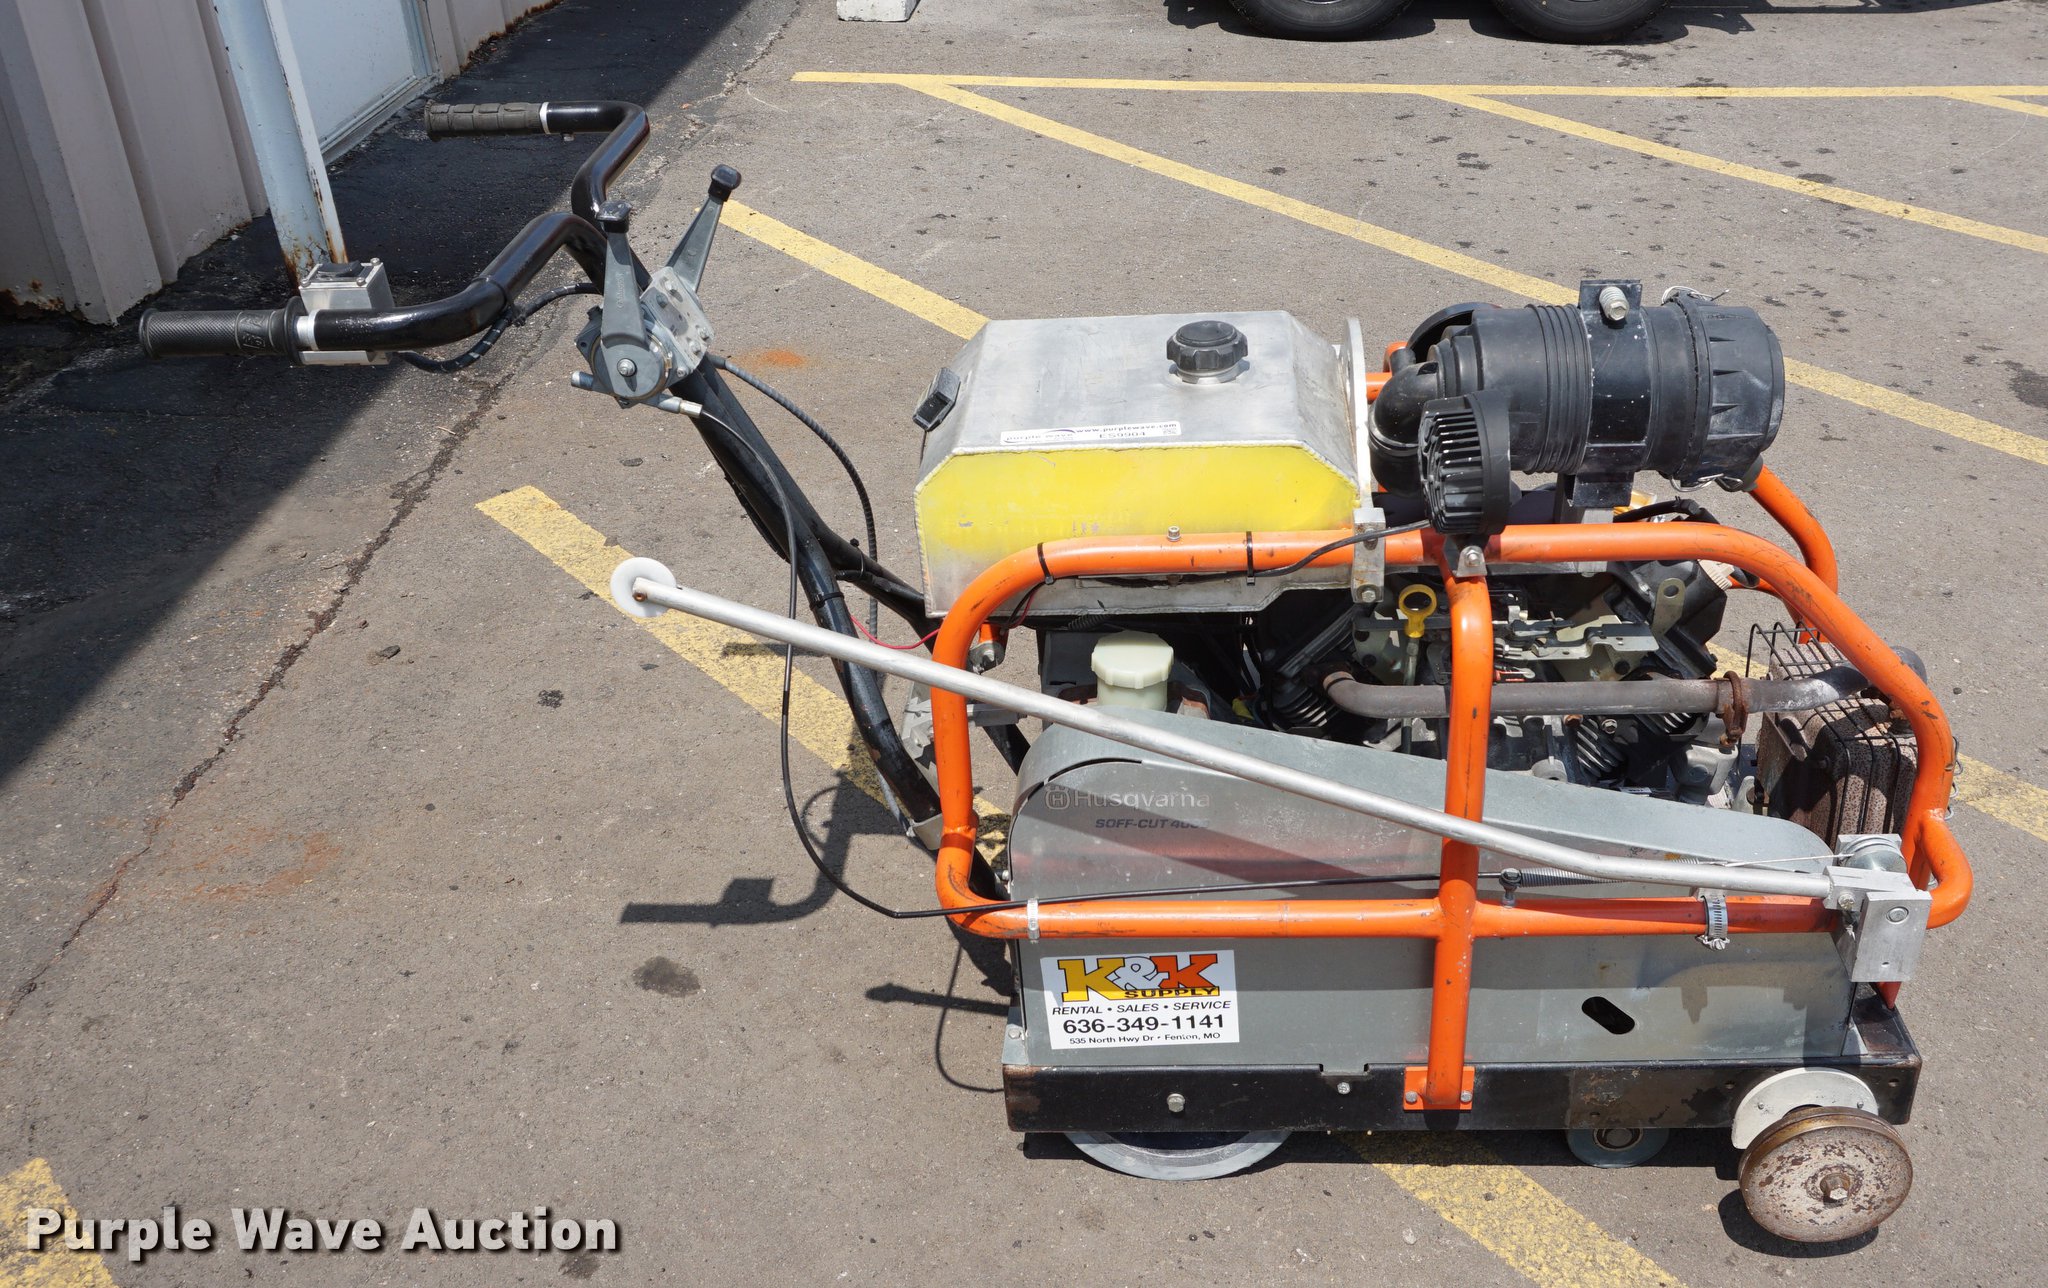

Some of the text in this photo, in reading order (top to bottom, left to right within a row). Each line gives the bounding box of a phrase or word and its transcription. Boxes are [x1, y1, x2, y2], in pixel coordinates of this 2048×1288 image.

[1074, 790, 1210, 809] Husqvarna
[1095, 818, 1168, 828] SOFF-CUT
[1057, 953, 1218, 1002] K&K
[1124, 988, 1216, 999] SUPPLY
[1052, 1000, 1232, 1016] RENTAL SALES SERVICE
[1063, 1014, 1224, 1034] 636-349-1141
[1070, 1037, 1086, 1045] 535
[1089, 1036, 1116, 1044] North
[1119, 1035, 1140, 1043] Hwy
[1142, 1034, 1155, 1042] Dr
[1203, 1031, 1221, 1040] MO
